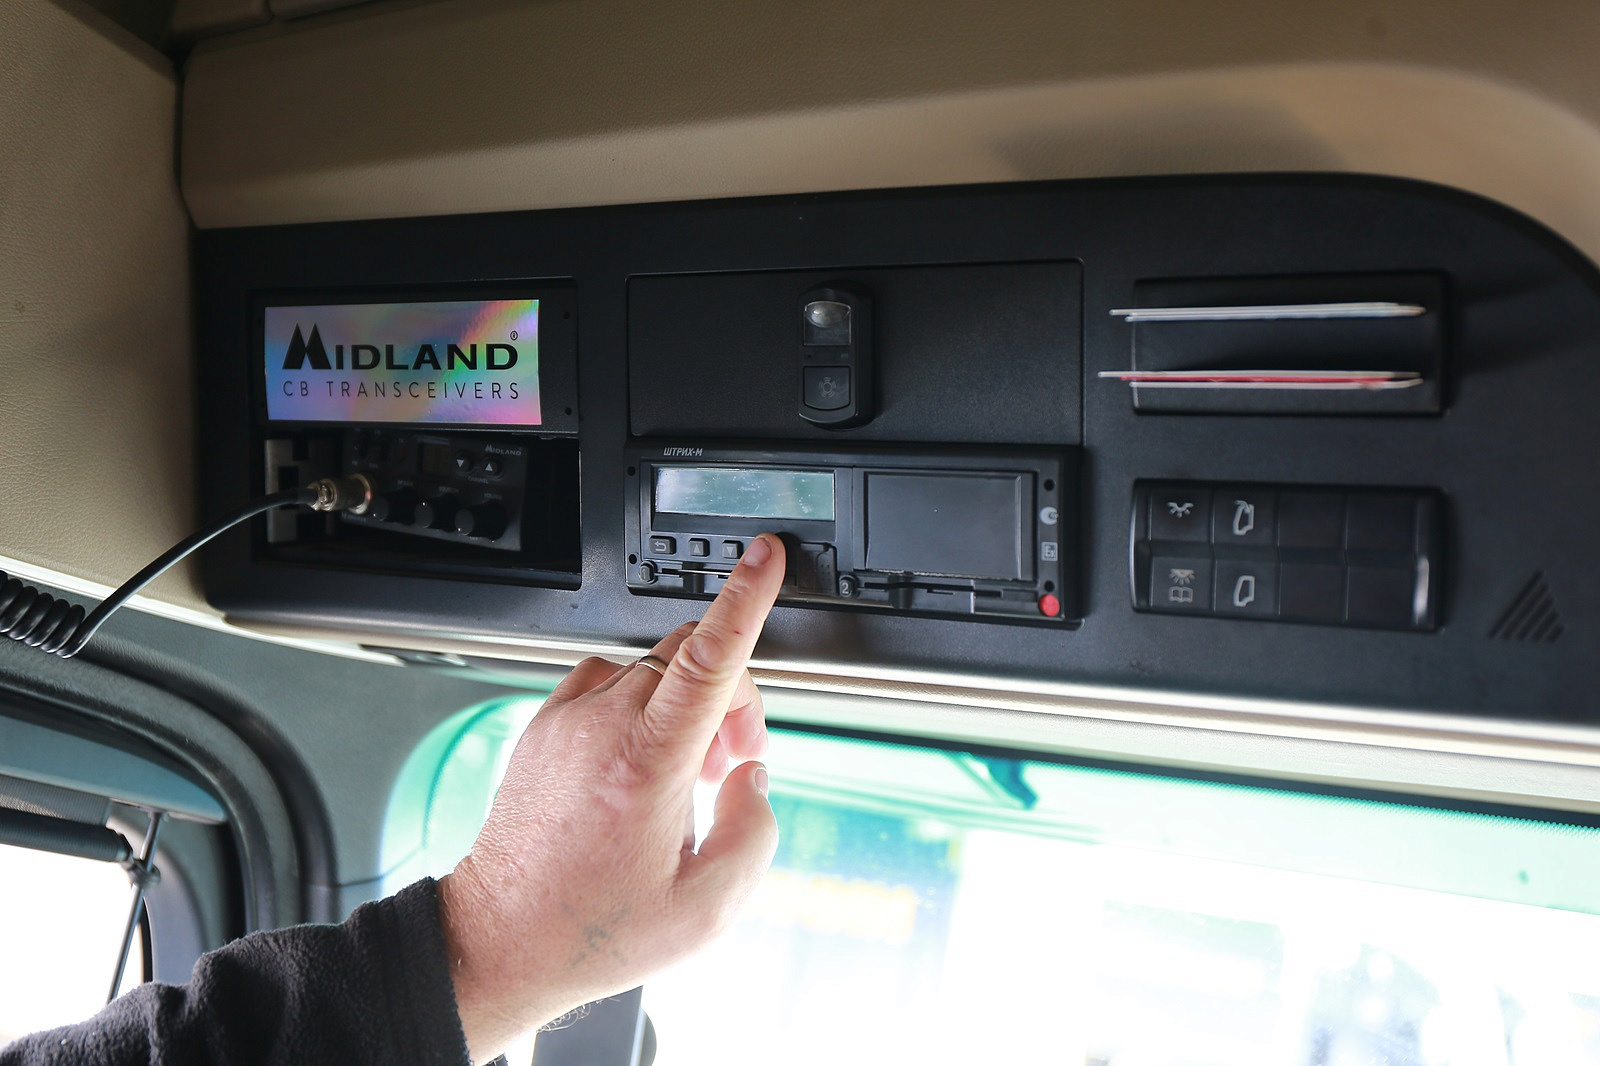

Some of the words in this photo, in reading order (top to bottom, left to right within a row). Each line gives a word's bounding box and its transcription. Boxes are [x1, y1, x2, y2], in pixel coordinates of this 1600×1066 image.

[282, 322, 518, 370] MIDLAND
[283, 380, 309, 397] CB
[326, 381, 519, 400] TRANSCEIVERS
[841, 581, 849, 595] 2
